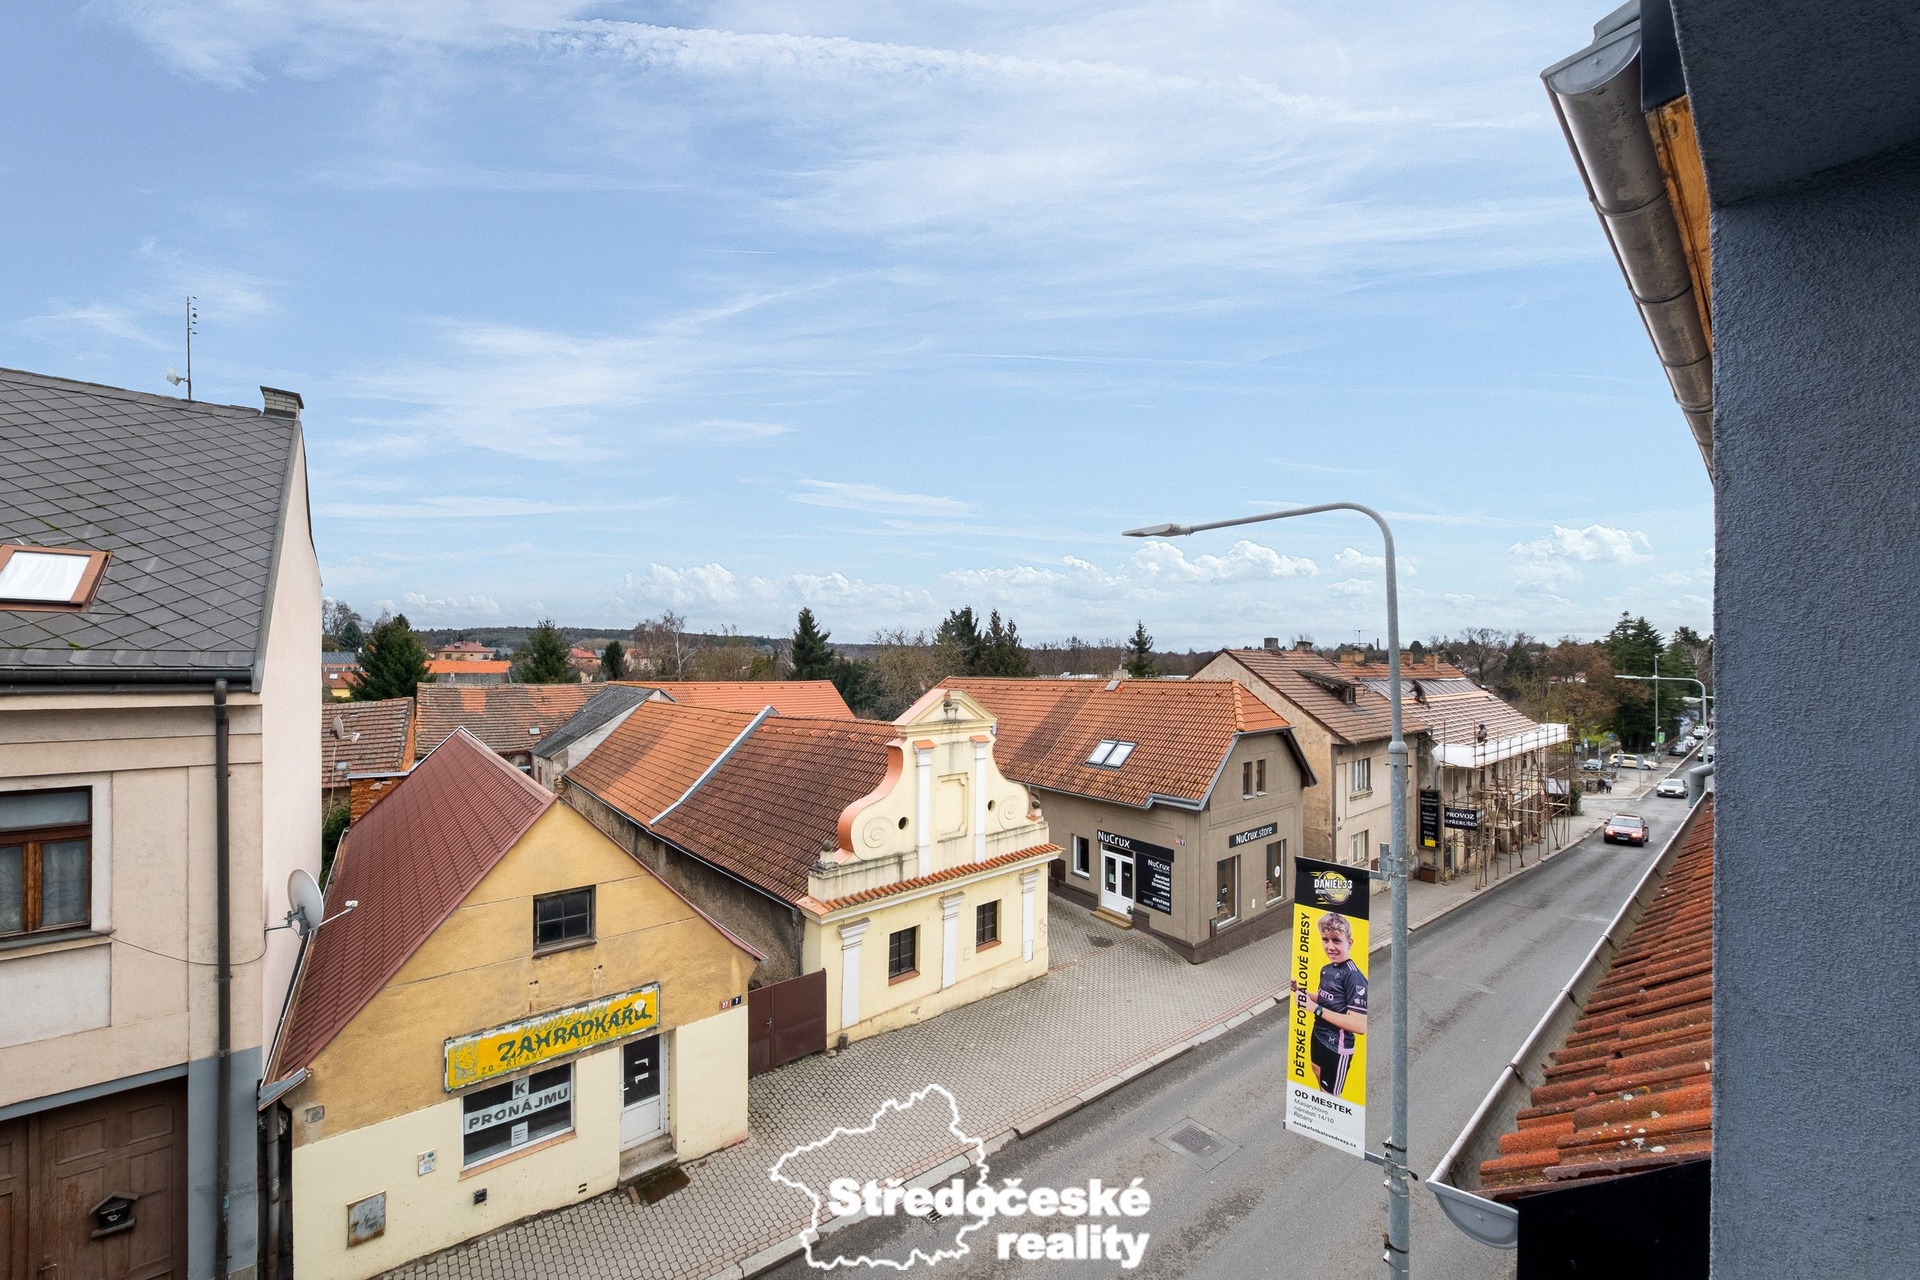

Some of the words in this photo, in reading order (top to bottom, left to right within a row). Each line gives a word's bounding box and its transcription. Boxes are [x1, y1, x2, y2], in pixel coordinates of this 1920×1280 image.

[1446, 812, 1474, 820] PROVOZ
[1098, 831, 1130, 848] NuCrux
[1236, 827, 1272, 844] NuCrux.store
[1148, 859, 1170, 871] NuCrux
[1300, 912, 1310, 952] DRESY
[1297, 956, 1309, 1026] FOTBALOVÉ
[1294, 1028, 1306, 1077] DĚTSKÉ
[515, 1083, 526, 1095] K
[469, 1088, 568, 1129] PRONÁJMU
[1294, 1099, 1328, 1114] Masarykovo
[1295, 1090, 1308, 1099] OD
[1312, 1095, 1352, 1116] MESTEK
[1318, 1114, 1334, 1124] 14/10
